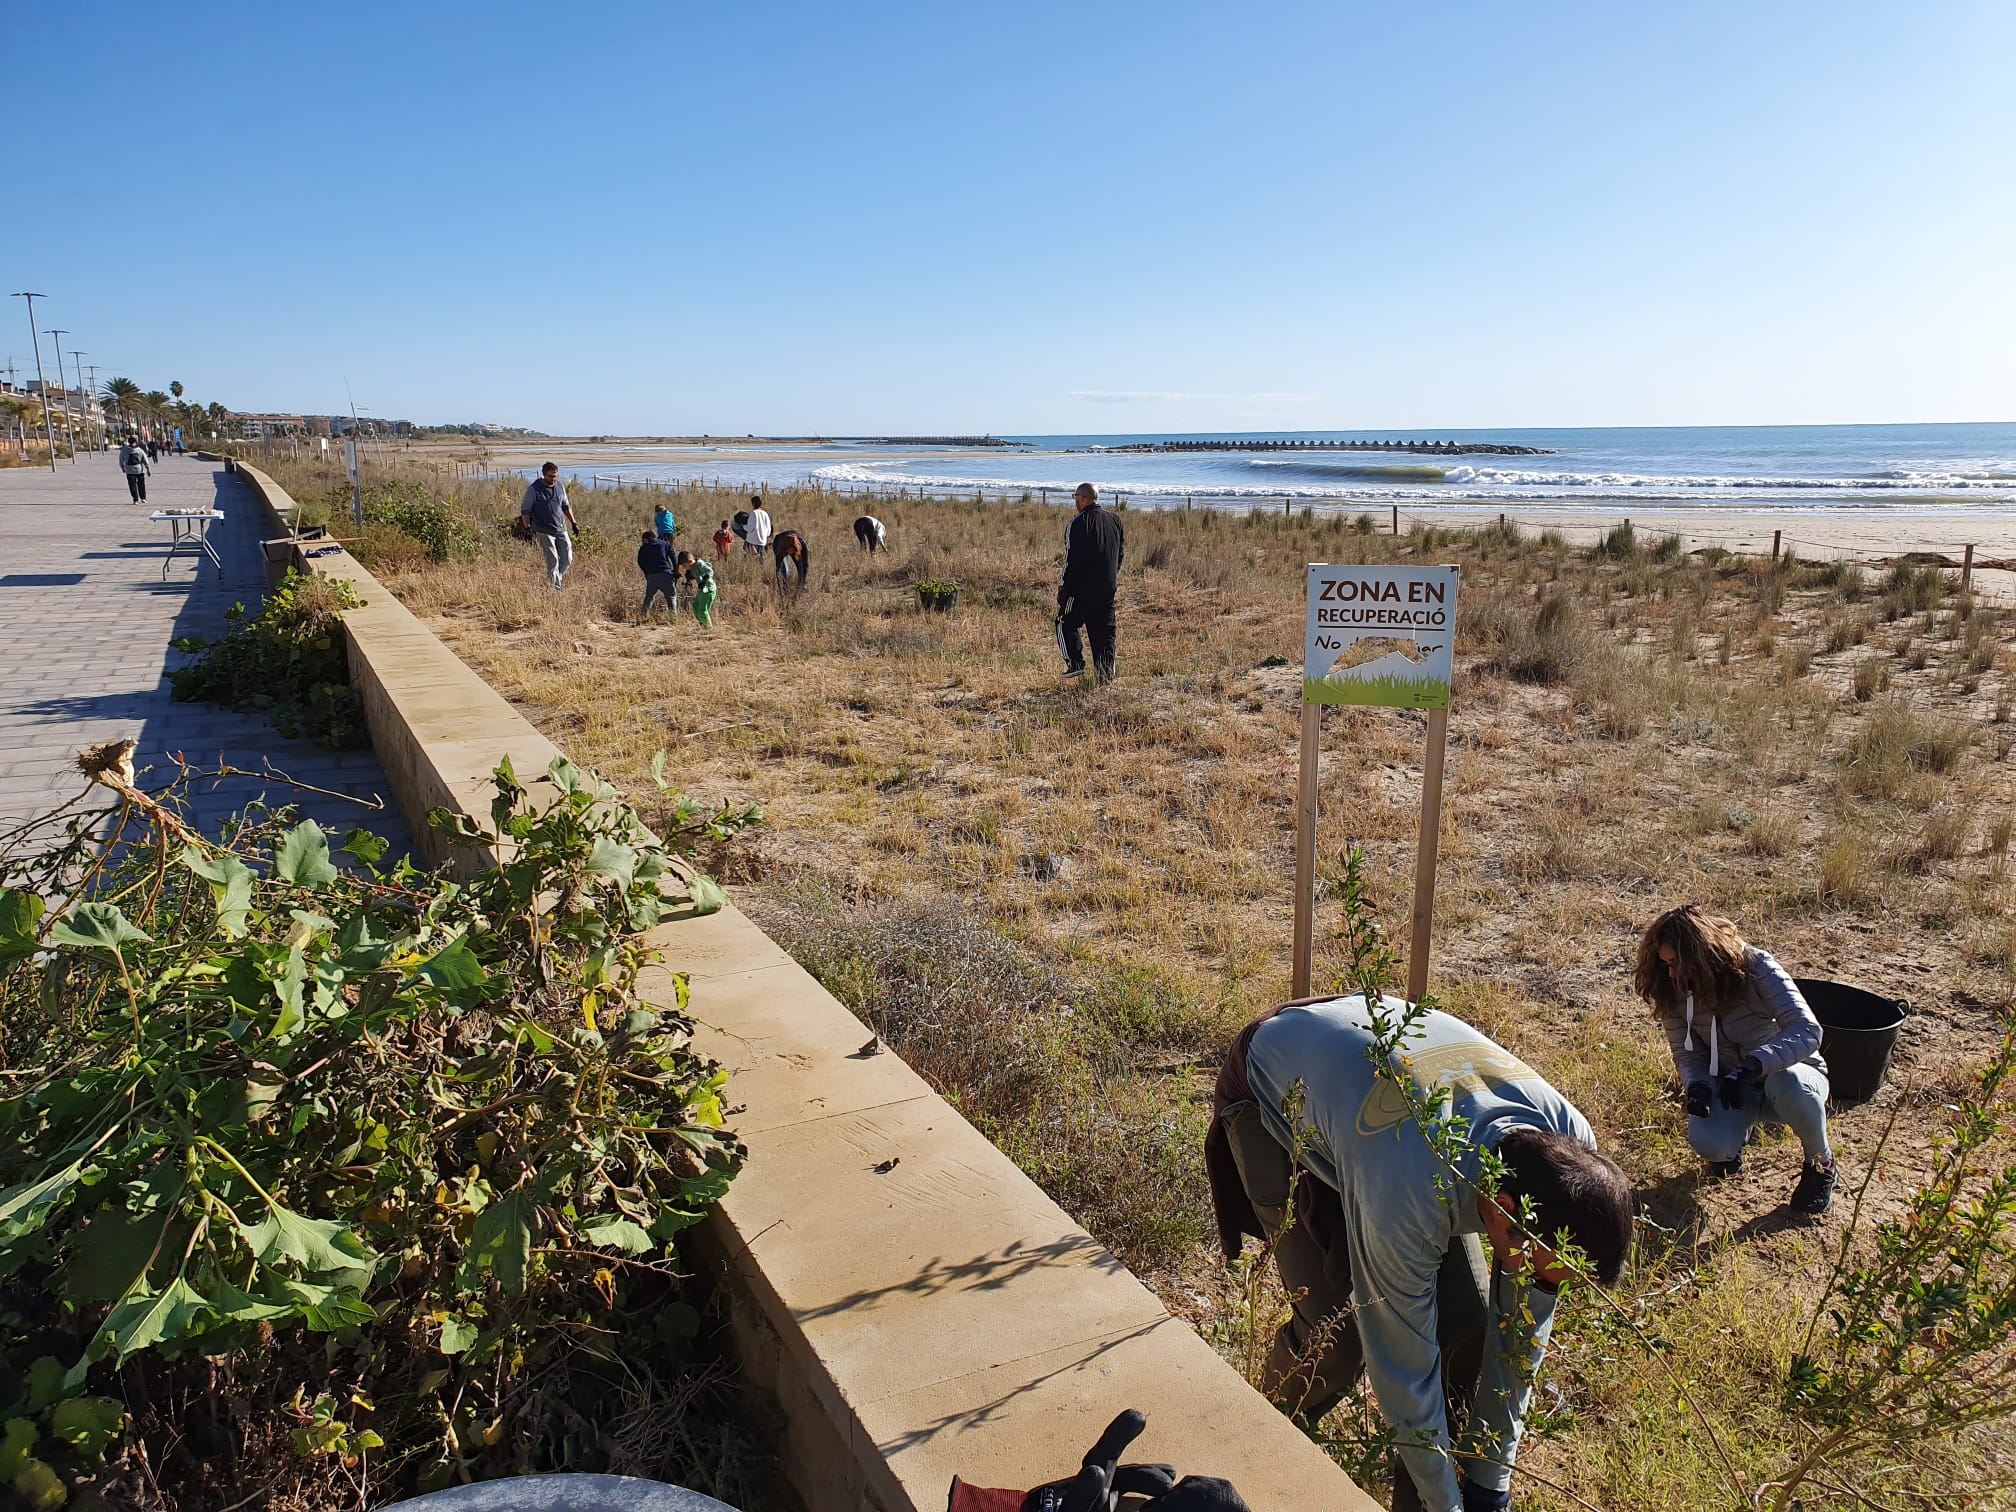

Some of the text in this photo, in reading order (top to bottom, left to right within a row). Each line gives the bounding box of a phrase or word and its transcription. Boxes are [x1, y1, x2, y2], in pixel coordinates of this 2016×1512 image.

[1319, 580, 1445, 603] ZONA EN
[1317, 608, 1446, 625] RECUPERACIÓ
[1314, 635, 1342, 650] No
